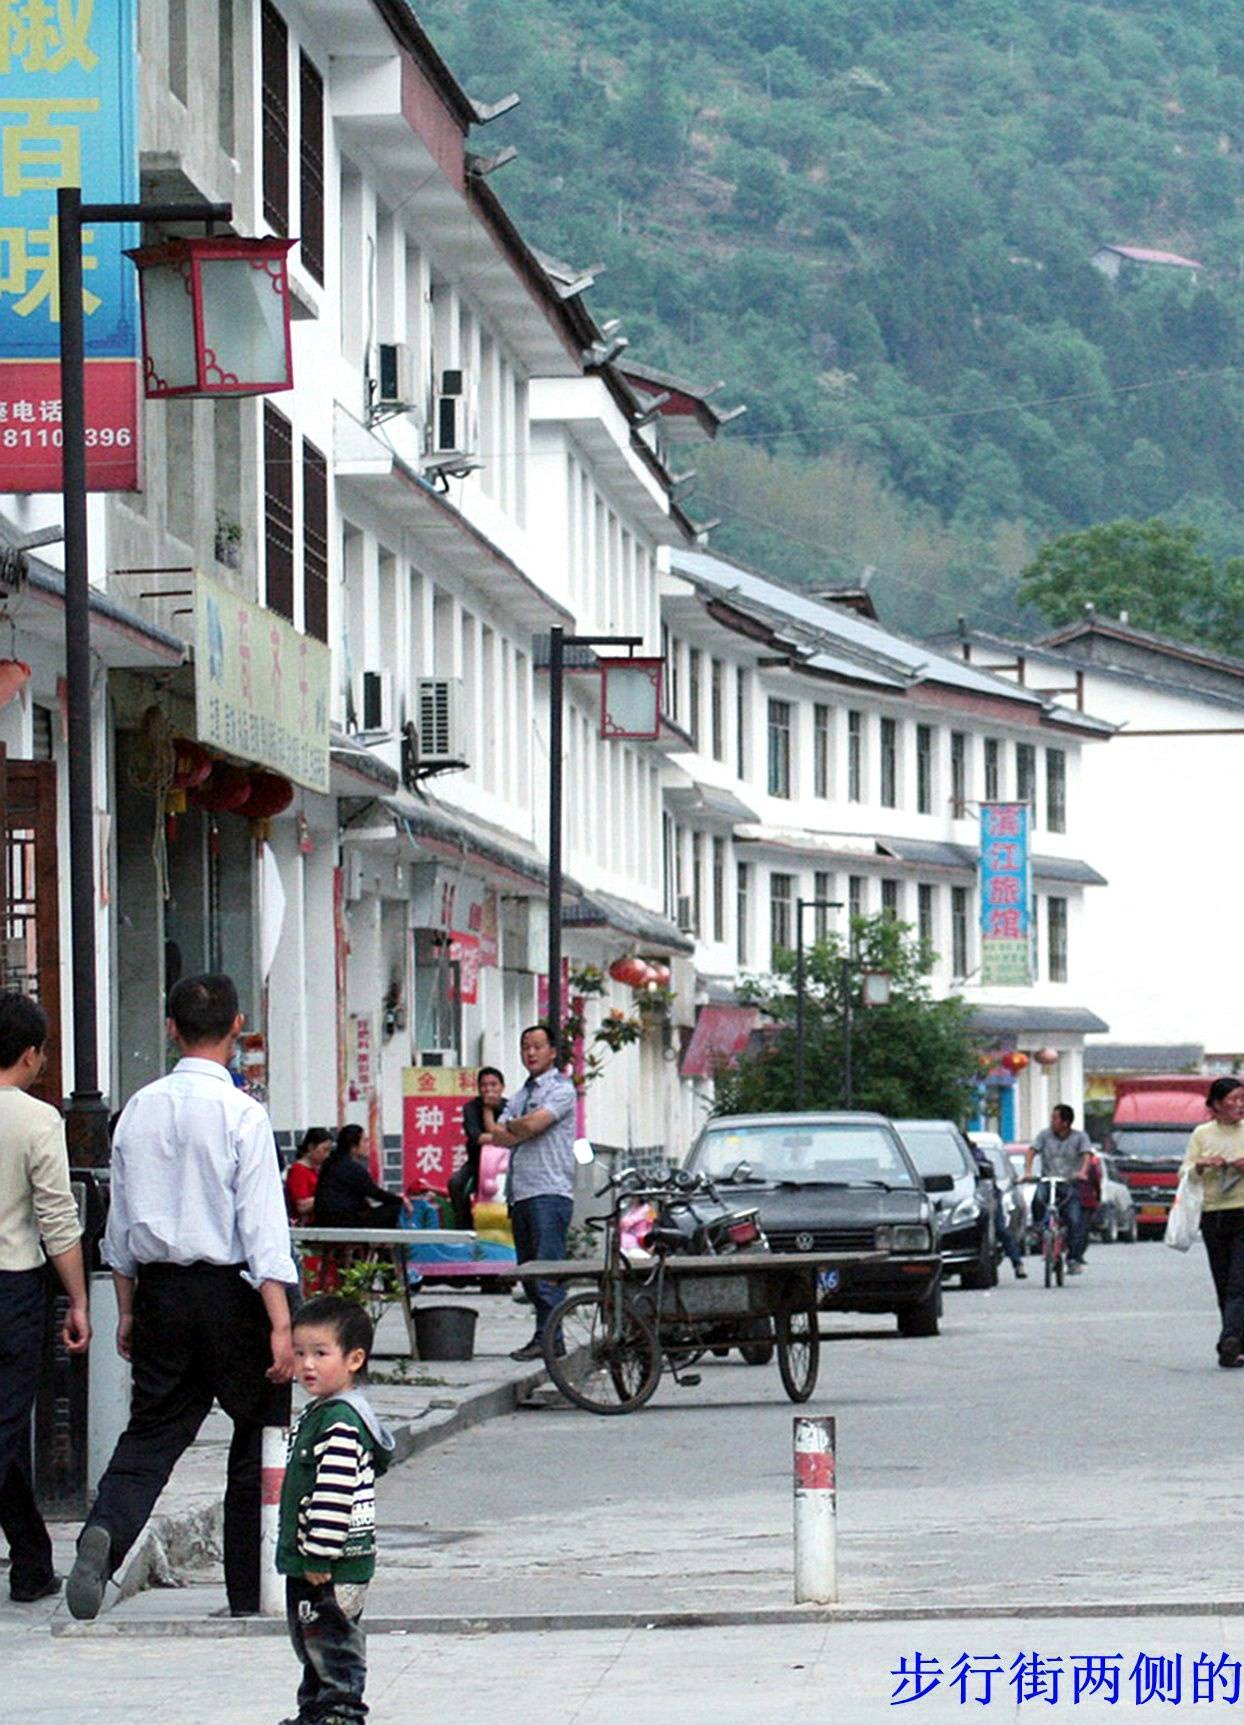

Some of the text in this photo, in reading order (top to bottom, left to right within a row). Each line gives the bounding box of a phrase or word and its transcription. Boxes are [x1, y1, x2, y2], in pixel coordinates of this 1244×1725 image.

[3, 427, 131, 447] 8110396
[990, 805, 1021, 938] 滨江旅馆
